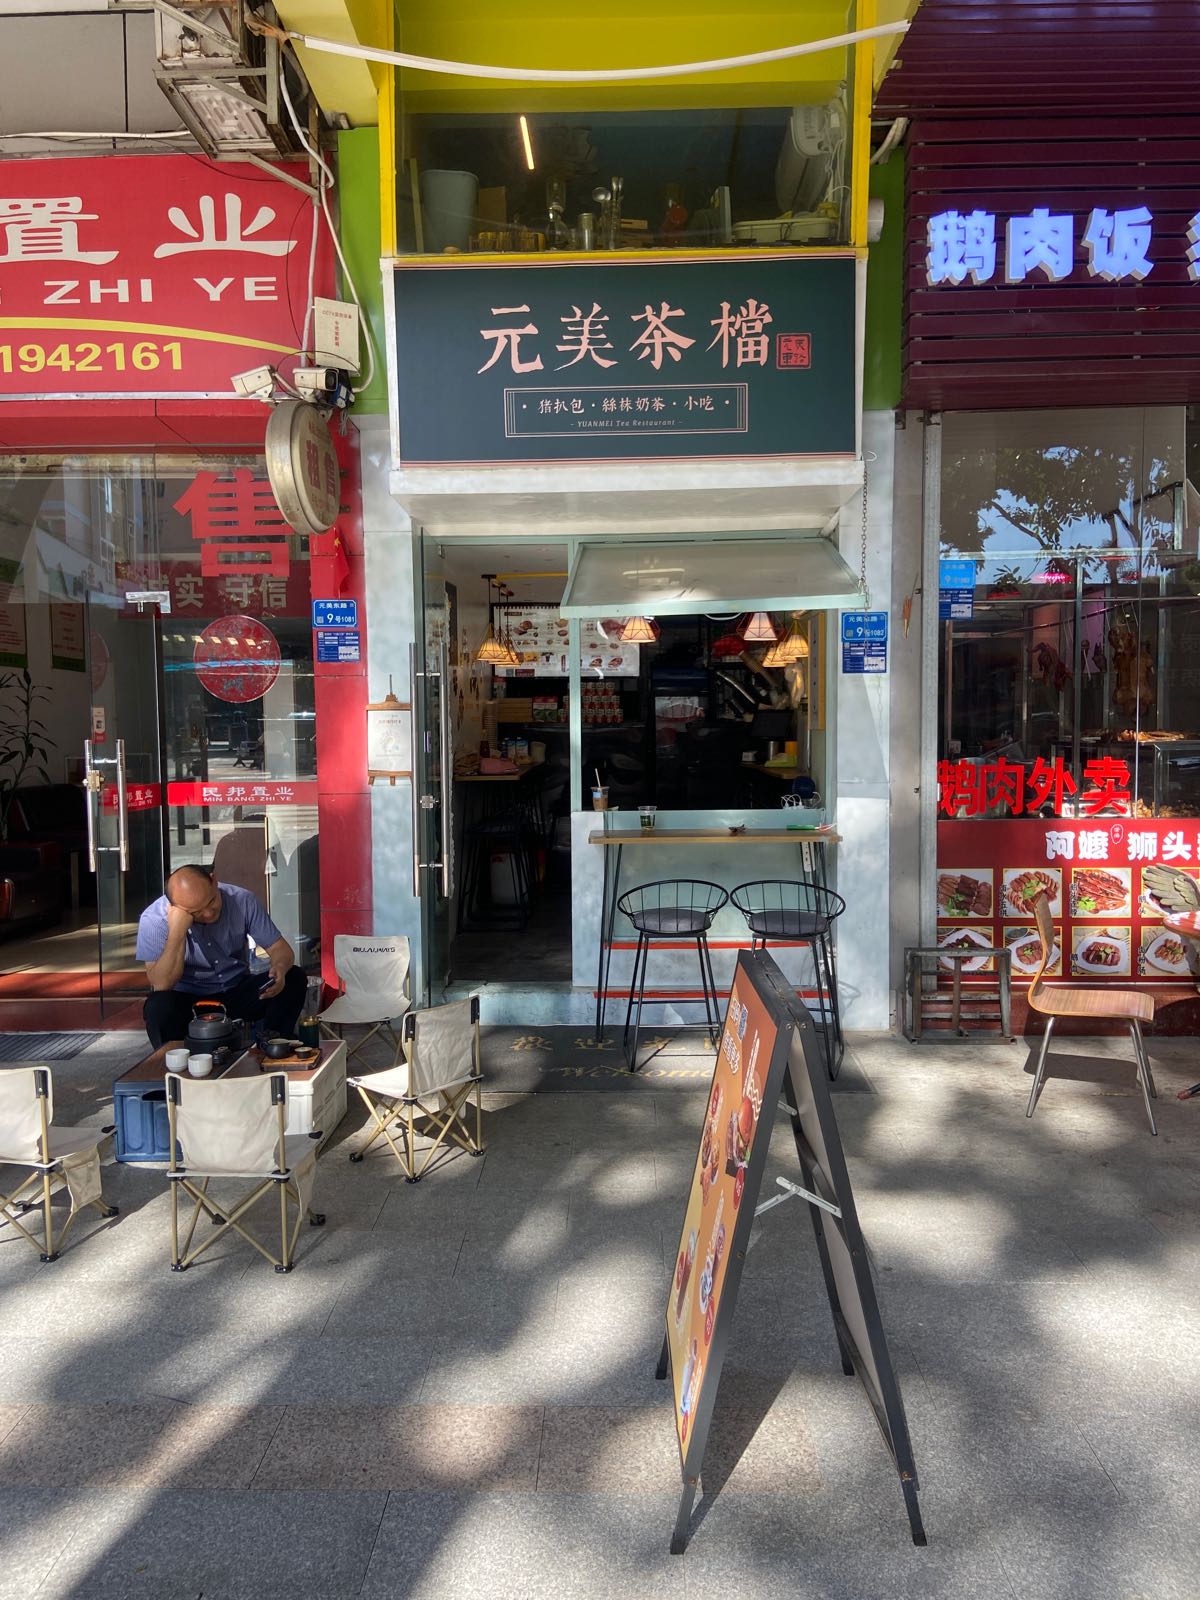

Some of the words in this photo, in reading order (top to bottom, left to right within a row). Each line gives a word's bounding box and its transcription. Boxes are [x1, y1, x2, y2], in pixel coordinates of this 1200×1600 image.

[0, 193, 298, 265] 置业
[926, 207, 1155, 286] 鹅肉饭
[43, 278, 153, 304] ZHI
[193, 277, 278, 301] YE
[477, 298, 773, 374] 元美茶檔
[0, 342, 182, 373] 1942161
[538, 398, 585, 414] 猪扒包
[684, 396, 715, 411] 小吃
[577, 420, 613, 428] YUANMEI
[632, 419, 676, 427] Restaurant
[172, 468, 294, 577] 售
[225, 573, 289, 608] 守信
[202, 786, 294, 797] 民邦置业
[1127, 831, 1200, 860] 狮头
